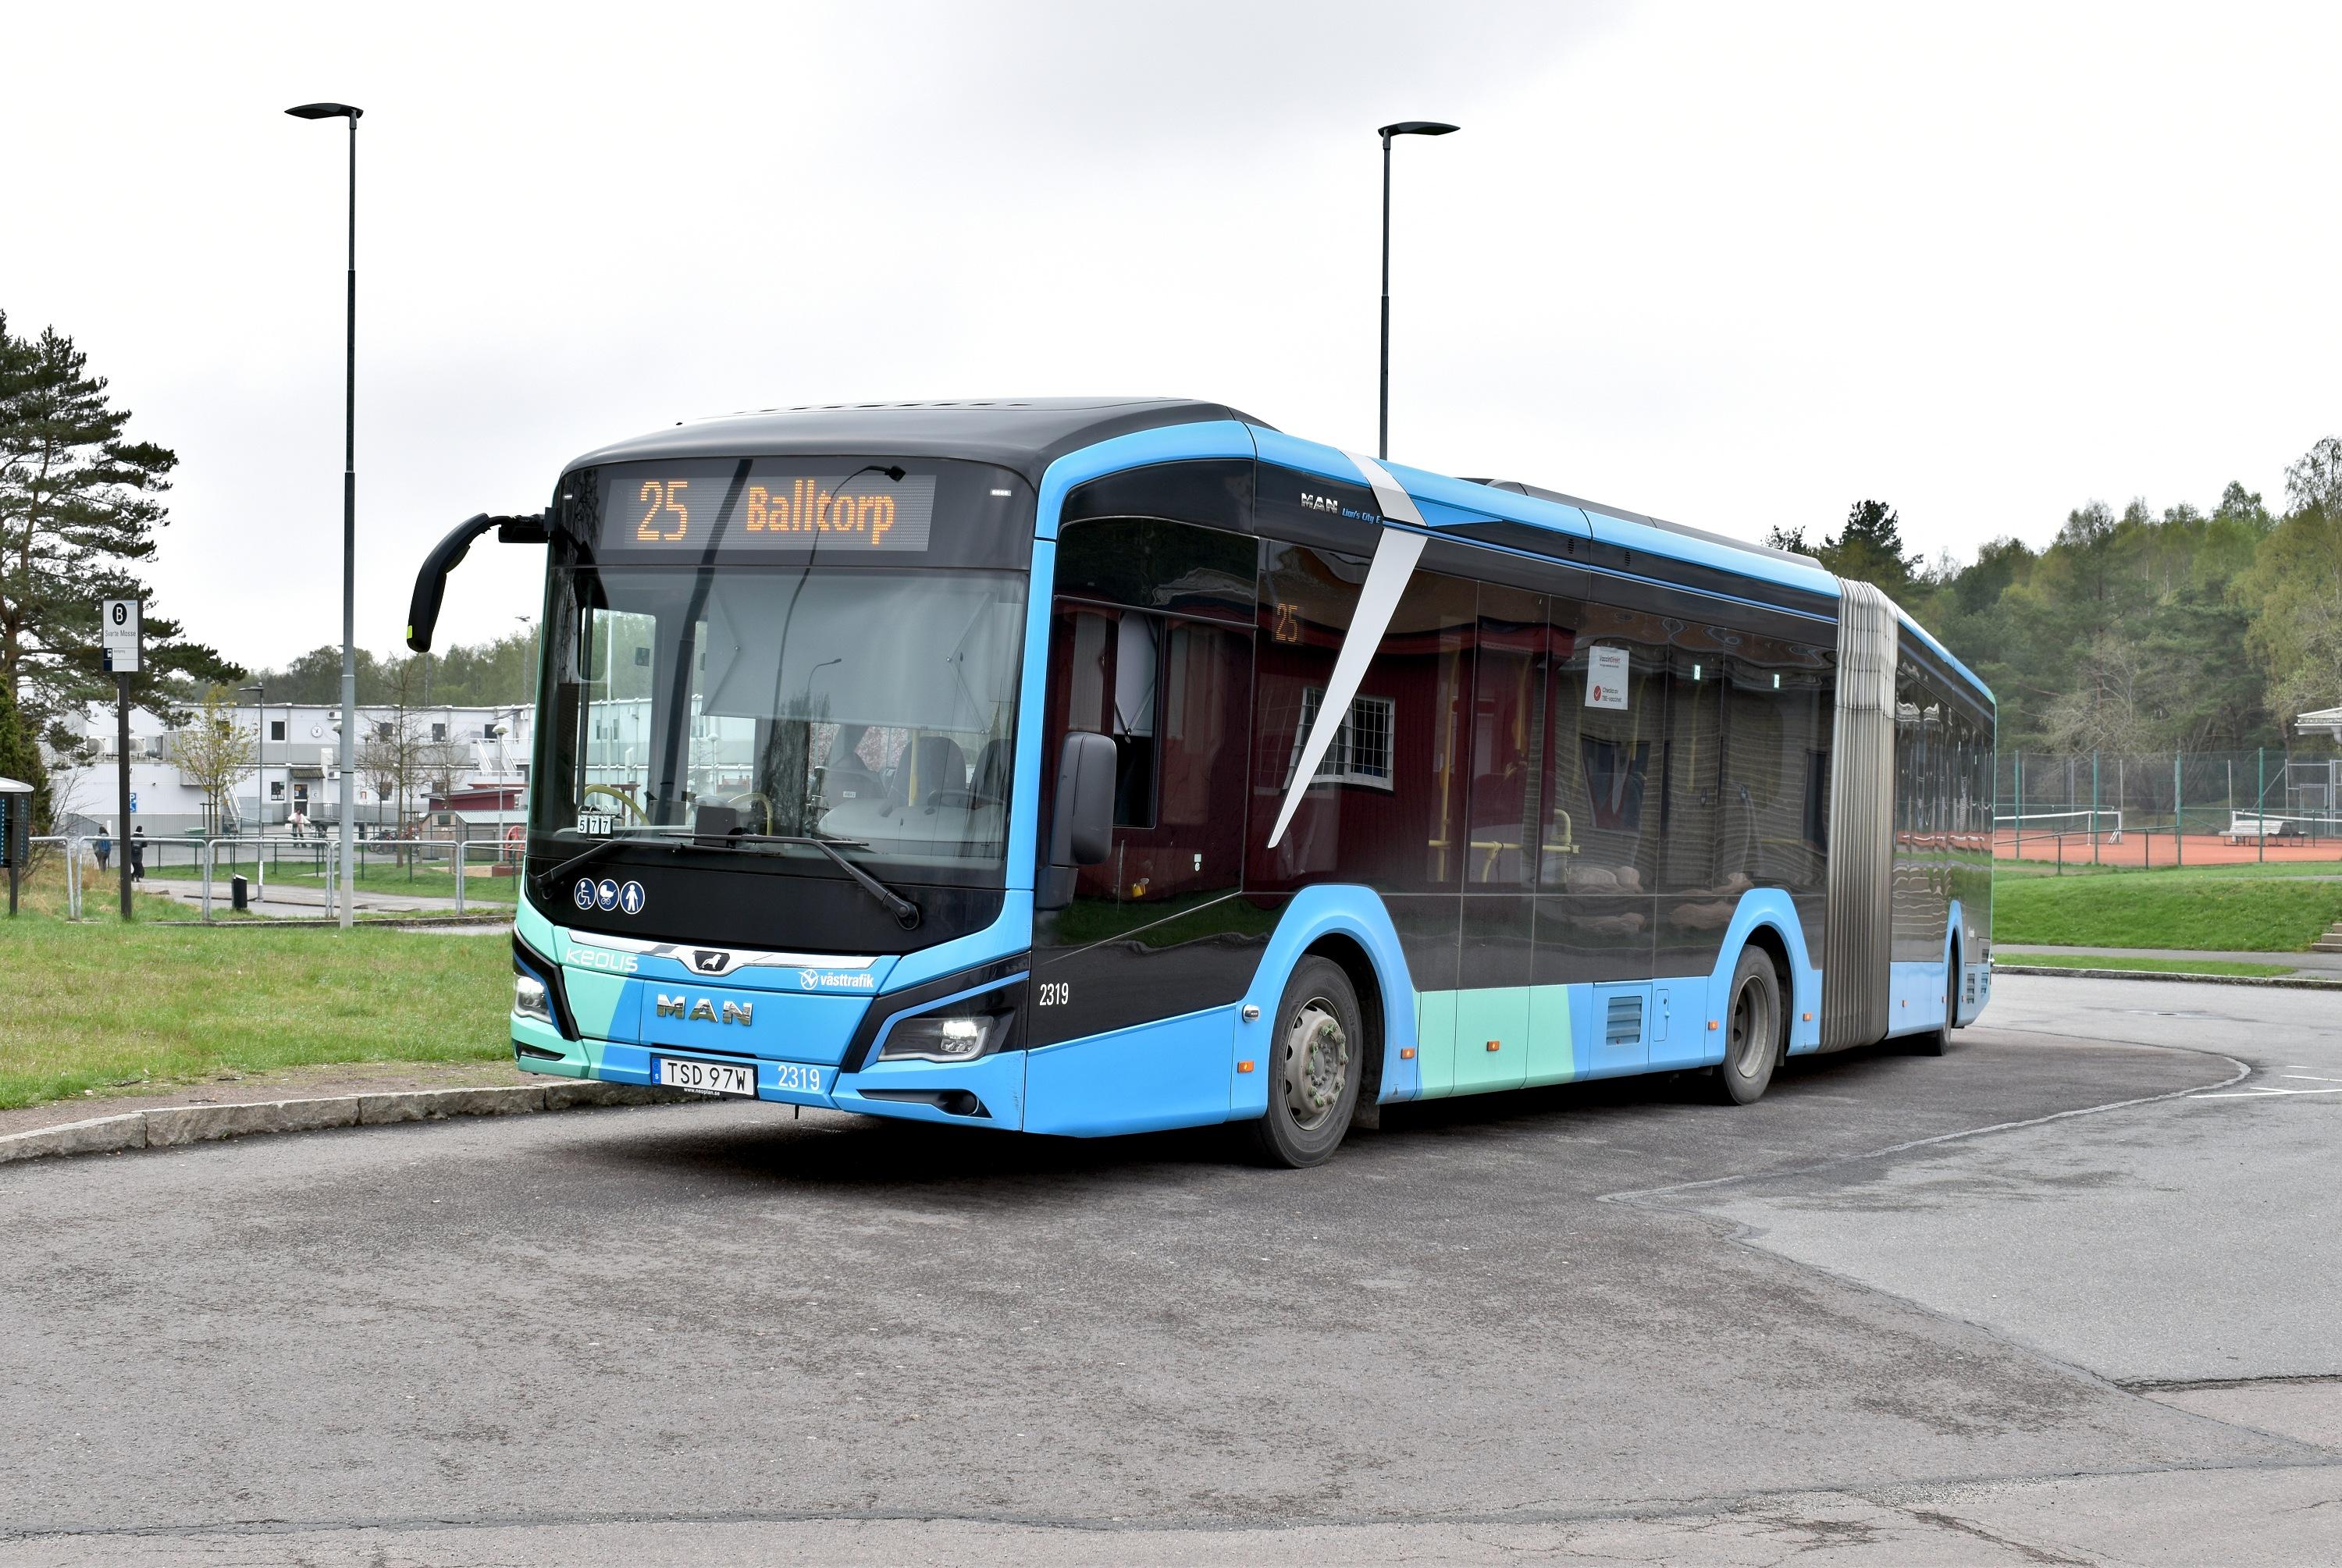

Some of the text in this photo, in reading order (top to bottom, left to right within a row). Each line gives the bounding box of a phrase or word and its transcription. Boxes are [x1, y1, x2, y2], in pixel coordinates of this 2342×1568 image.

[637, 479, 895, 545] 25 Balltorp
[1301, 492, 1338, 513] MAN
[1342, 507, 1381, 524] Lion's City E
[116, 606, 123, 622] B
[1276, 603, 1299, 642] 25
[579, 820, 608, 833] 577
[820, 972, 874, 987] västtrafik
[1039, 982, 1069, 1006] 2319
[656, 994, 754, 1027] MAN
[667, 1062, 746, 1091] TSD 97W
[778, 1065, 820, 1091] 2319
[683, 1087, 721, 1097] www.neoplan.se
